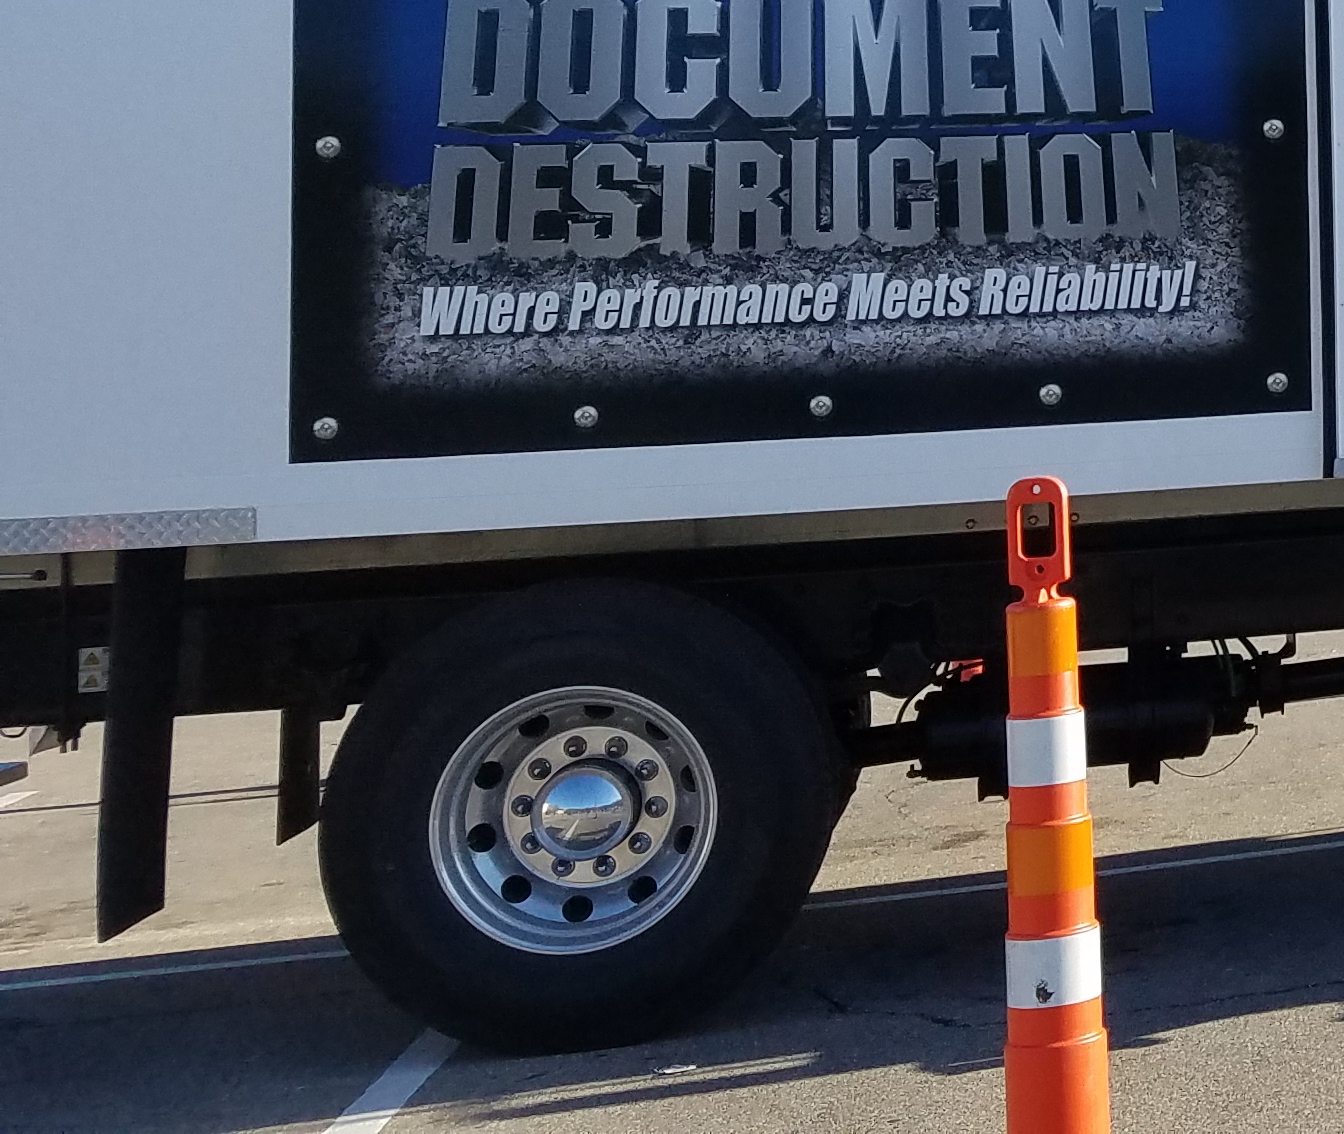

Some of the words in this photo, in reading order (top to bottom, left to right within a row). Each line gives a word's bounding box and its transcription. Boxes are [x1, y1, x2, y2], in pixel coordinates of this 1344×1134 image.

[425, 131, 1180, 258] DESTRUCTION
[419, 286, 560, 336] Where
[567, 279, 838, 331] Performance
[845, 273, 970, 321] Meets
[978, 261, 1196, 316] Reliability!
